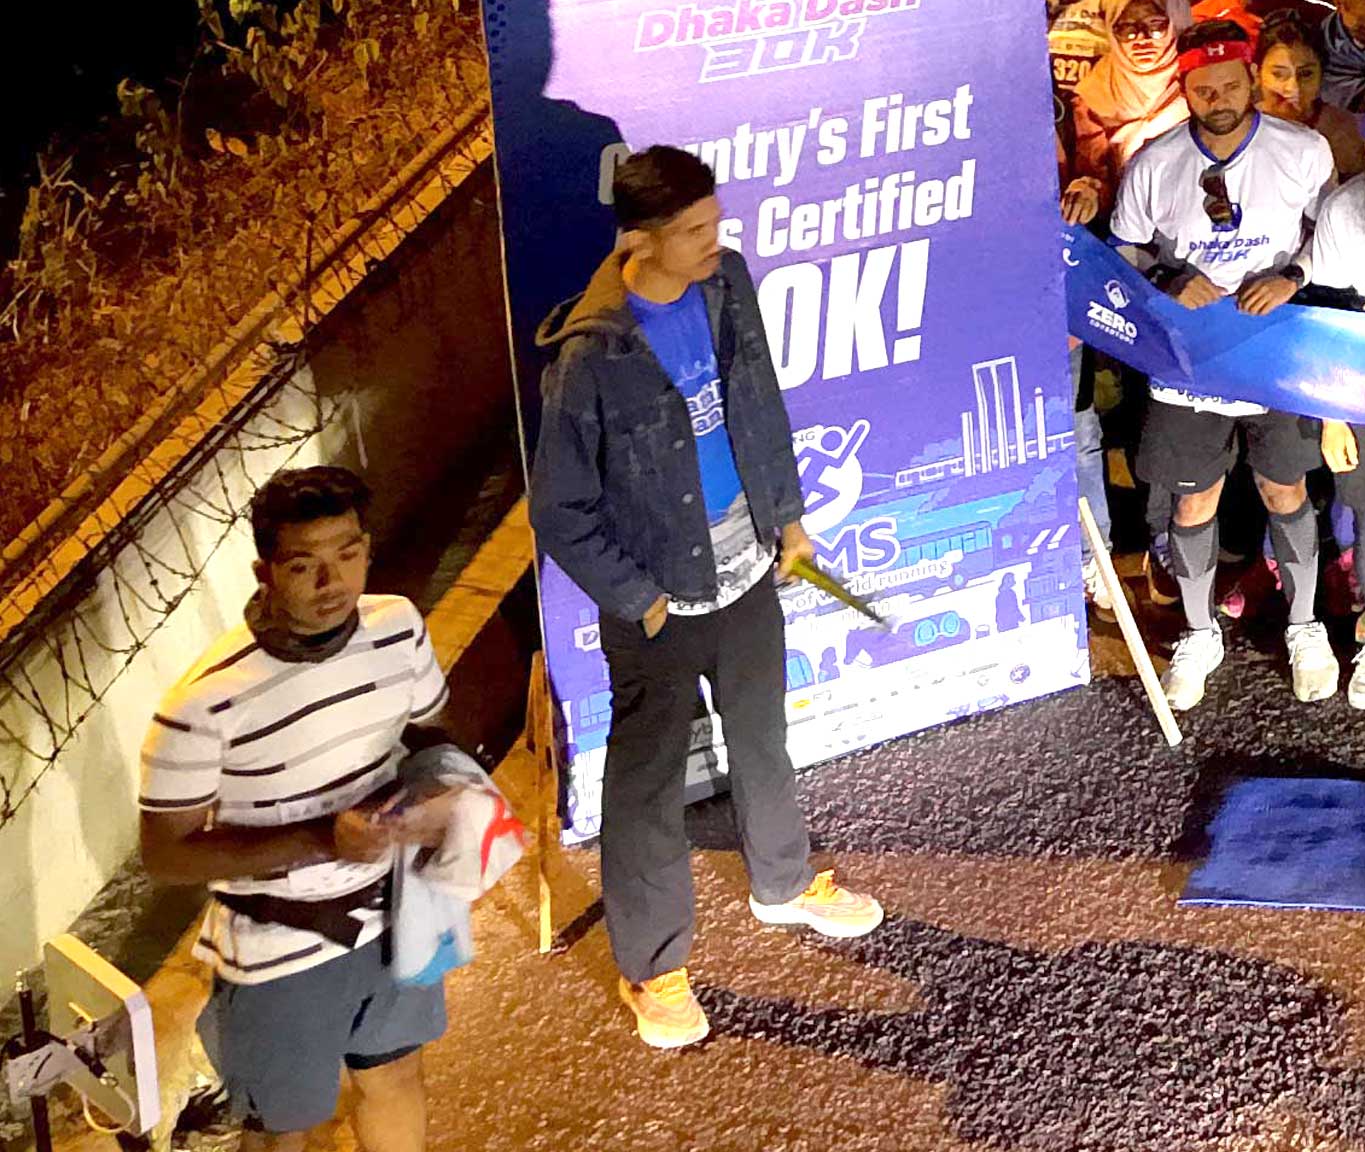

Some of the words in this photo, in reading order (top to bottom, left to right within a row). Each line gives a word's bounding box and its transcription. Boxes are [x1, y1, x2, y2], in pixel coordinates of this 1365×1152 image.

[699, 18, 867, 83] 30K
[859, 83, 975, 158] First
[755, 158, 977, 259] Certified
[1234, 234, 1271, 248] Dash
[1086, 300, 1138, 339] ZERO
